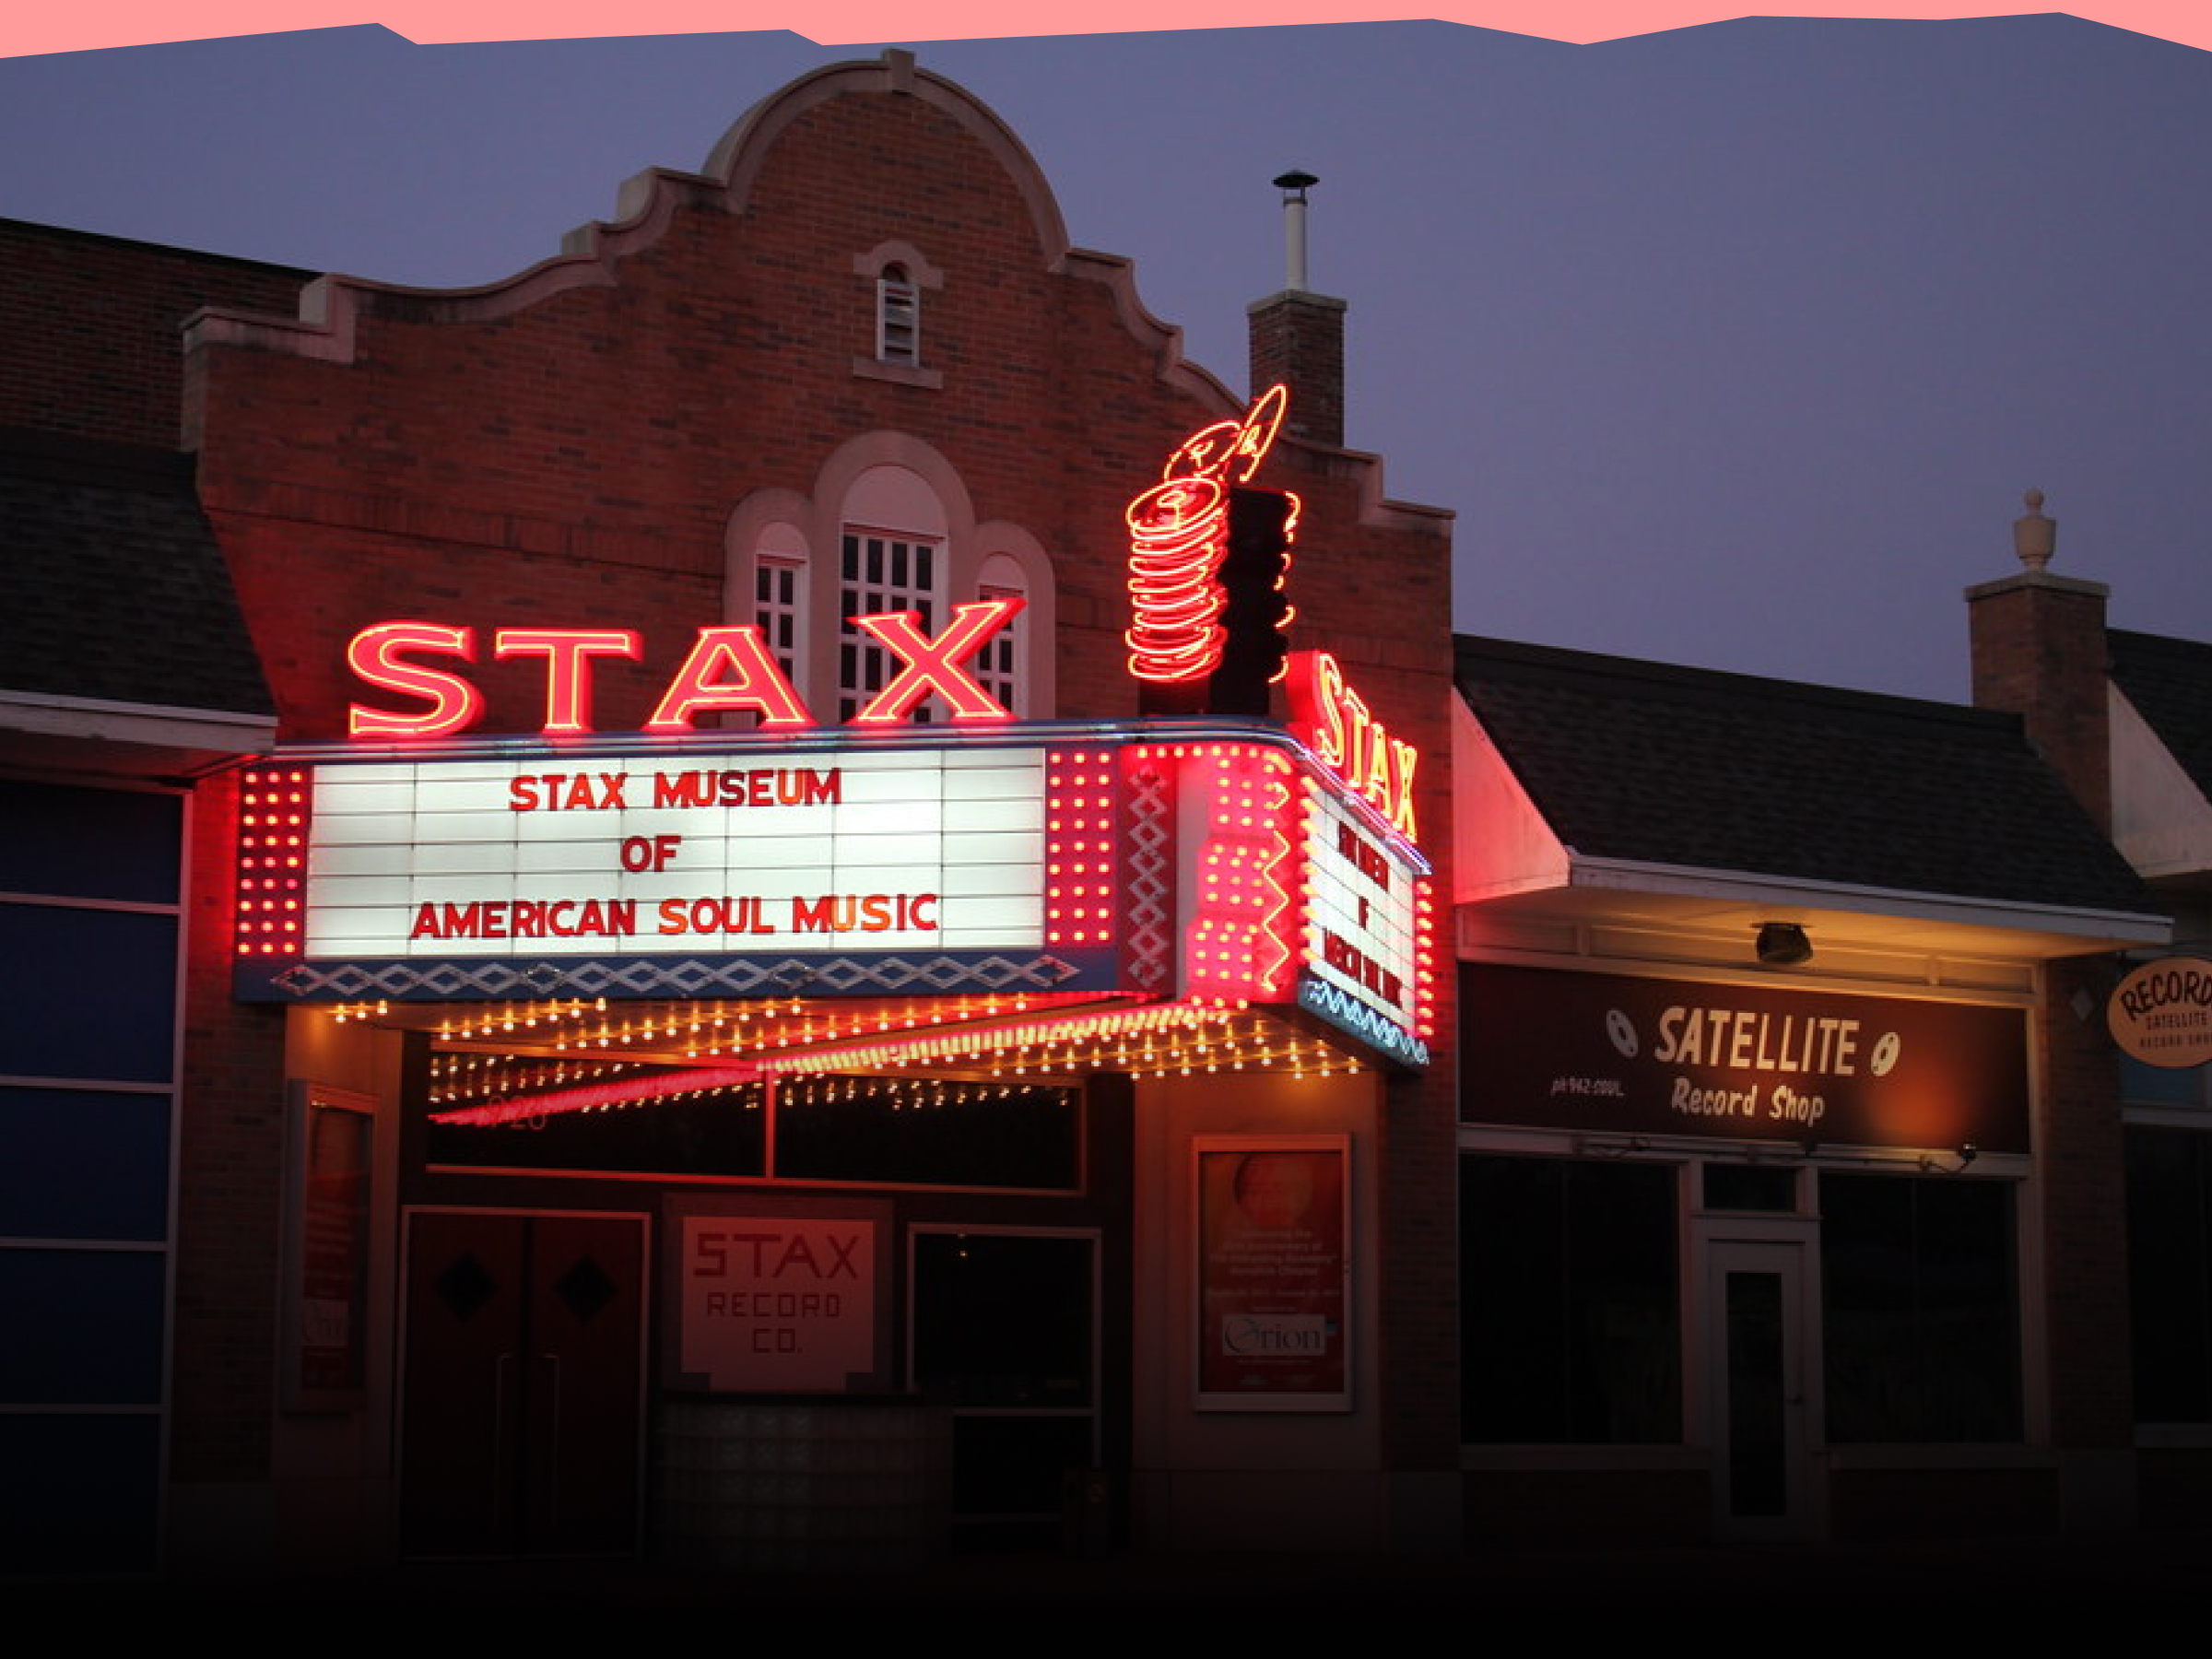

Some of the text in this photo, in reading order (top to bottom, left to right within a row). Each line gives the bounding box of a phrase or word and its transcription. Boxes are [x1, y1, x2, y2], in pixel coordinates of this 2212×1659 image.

[347, 597, 1026, 737] STAX
[1316, 652, 1418, 843] STAX
[509, 768, 841, 812] STAX MUSEUM
[619, 834, 681, 873] OF
[409, 894, 938, 940] AMERICAN SOUL MUSIC
[1654, 1006, 1861, 1077] SATELLITE
[2145, 1011, 2208, 1030] SATELLITE
[1671, 1077, 1826, 1127] Record Shop
[693, 1233, 859, 1280] STAX
[706, 1291, 841, 1318] RECORD
[752, 1328, 804, 1354] CO.
